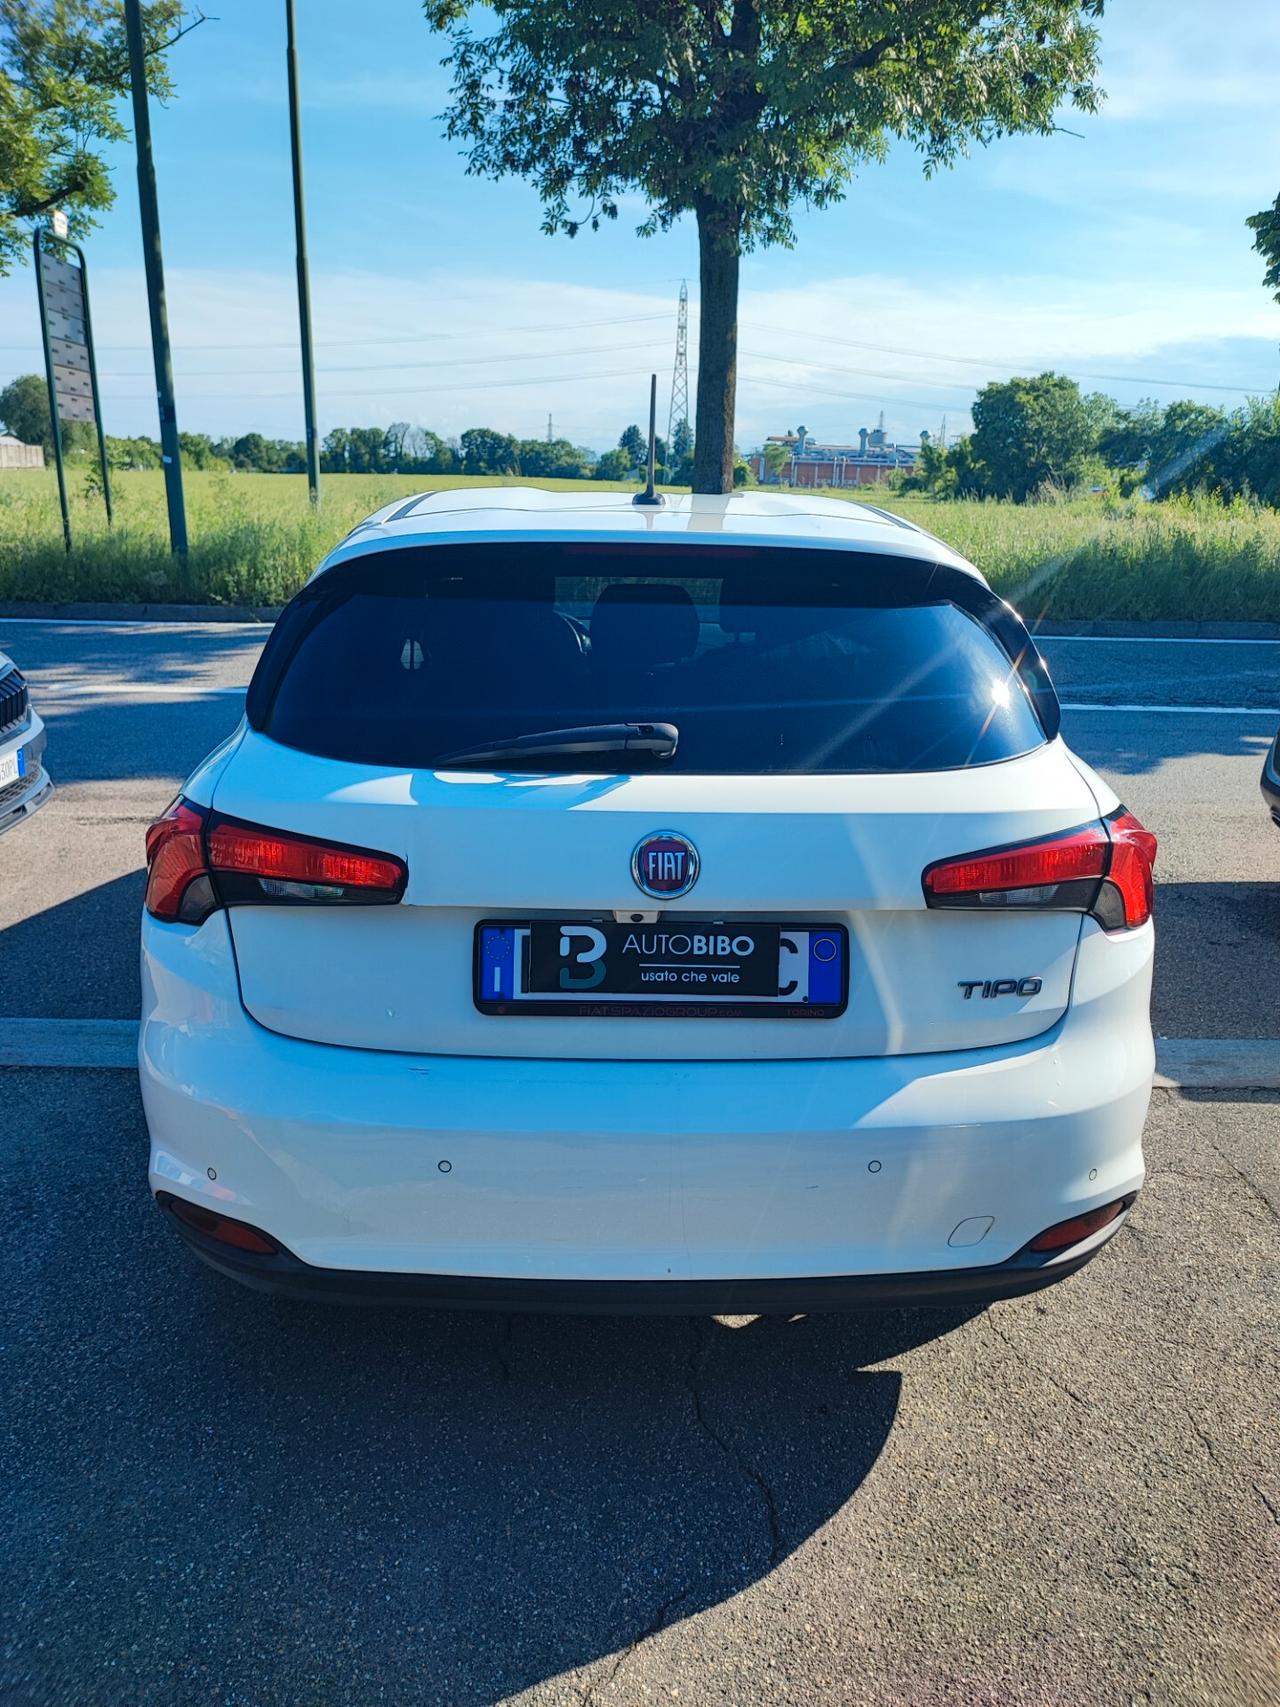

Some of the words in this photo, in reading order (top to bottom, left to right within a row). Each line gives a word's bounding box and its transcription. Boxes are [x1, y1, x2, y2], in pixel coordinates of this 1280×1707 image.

[648, 851, 685, 881] FIAT
[621, 933, 755, 957] AUTOBIBO
[640, 971, 678, 983] usato
[681, 971, 707, 983] che
[710, 972, 740, 984] vale
[957, 976, 1043, 999] TIPO
